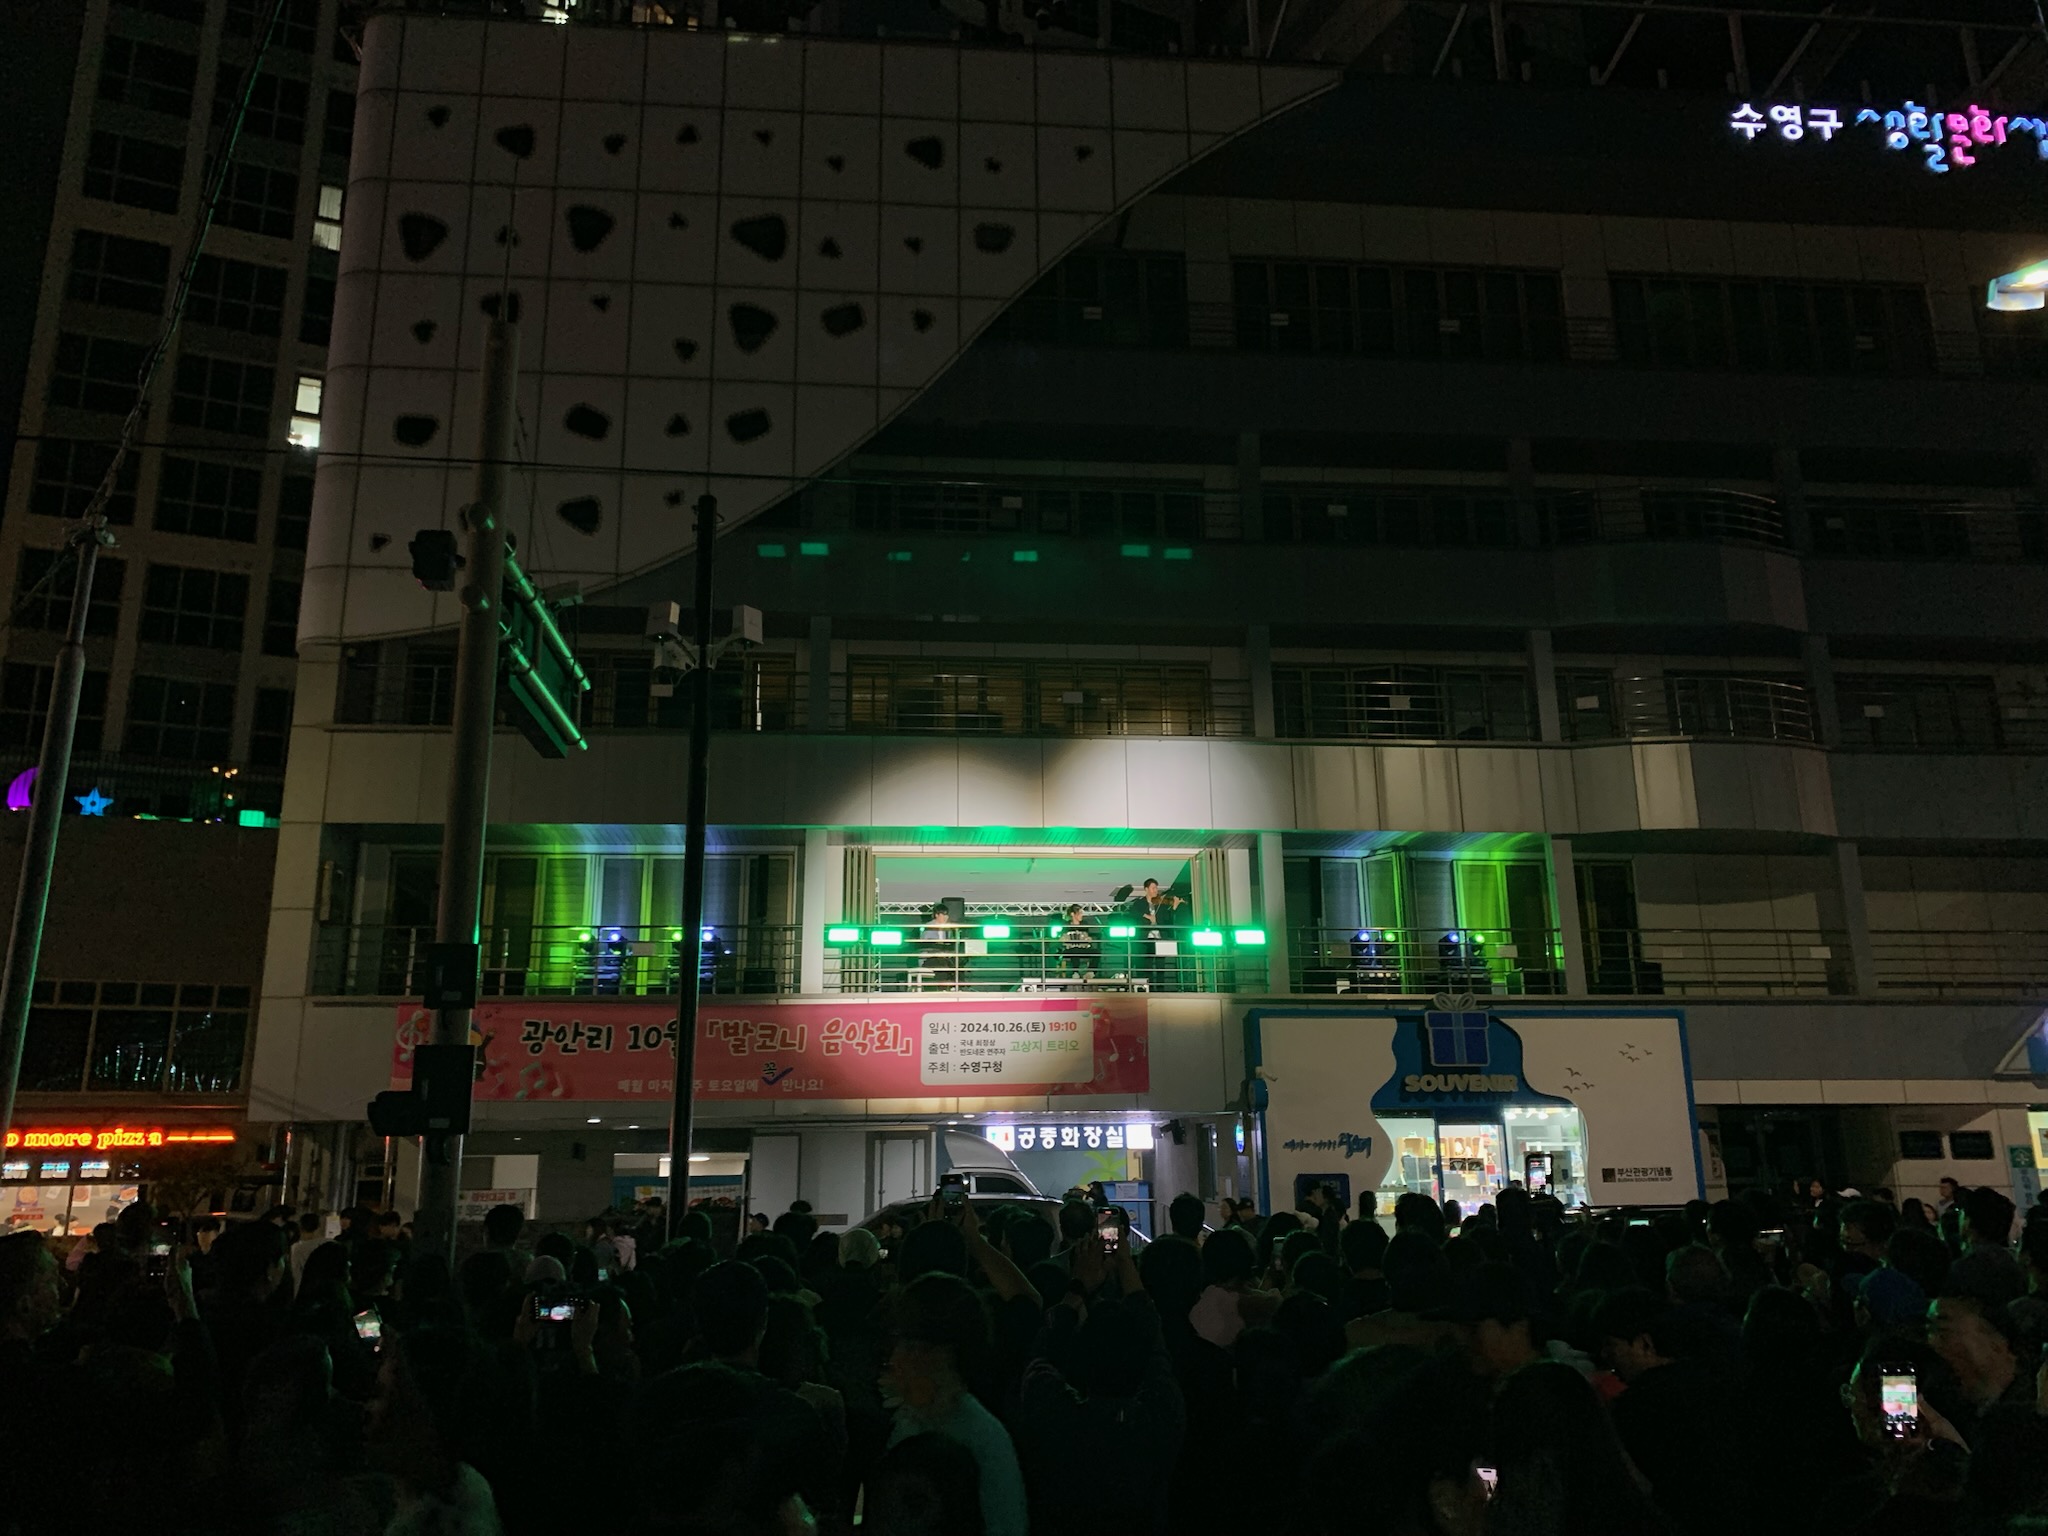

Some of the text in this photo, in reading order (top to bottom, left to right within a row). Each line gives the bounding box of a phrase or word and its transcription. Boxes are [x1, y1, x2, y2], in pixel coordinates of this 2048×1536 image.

[1731, 103, 1843, 141] 수영구
[929, 1022, 950, 1034] 일시
[960, 1021, 1046, 1033] 2024.10.26.(토)
[1049, 1021, 1077, 1032] 19:10
[521, 1020, 614, 1055] 광안리
[959, 1039, 973, 1047] 국내
[928, 1042, 950, 1055] 출연
[1010, 1039, 1080, 1053] 고상지 트리오
[928, 1061, 950, 1074] 주최
[960, 1060, 1003, 1073] 수영구청
[647, 1079, 676, 1093] 마지
[707, 1079, 759, 1093] 토요일에
[762, 1062, 778, 1078] 꼭
[781, 1079, 824, 1093] 만나요!
[1404, 1073, 1519, 1093] SOUVENIR
[23, 1132, 93, 1148] more
[1017, 1125, 1124, 1150] 공중화장실
